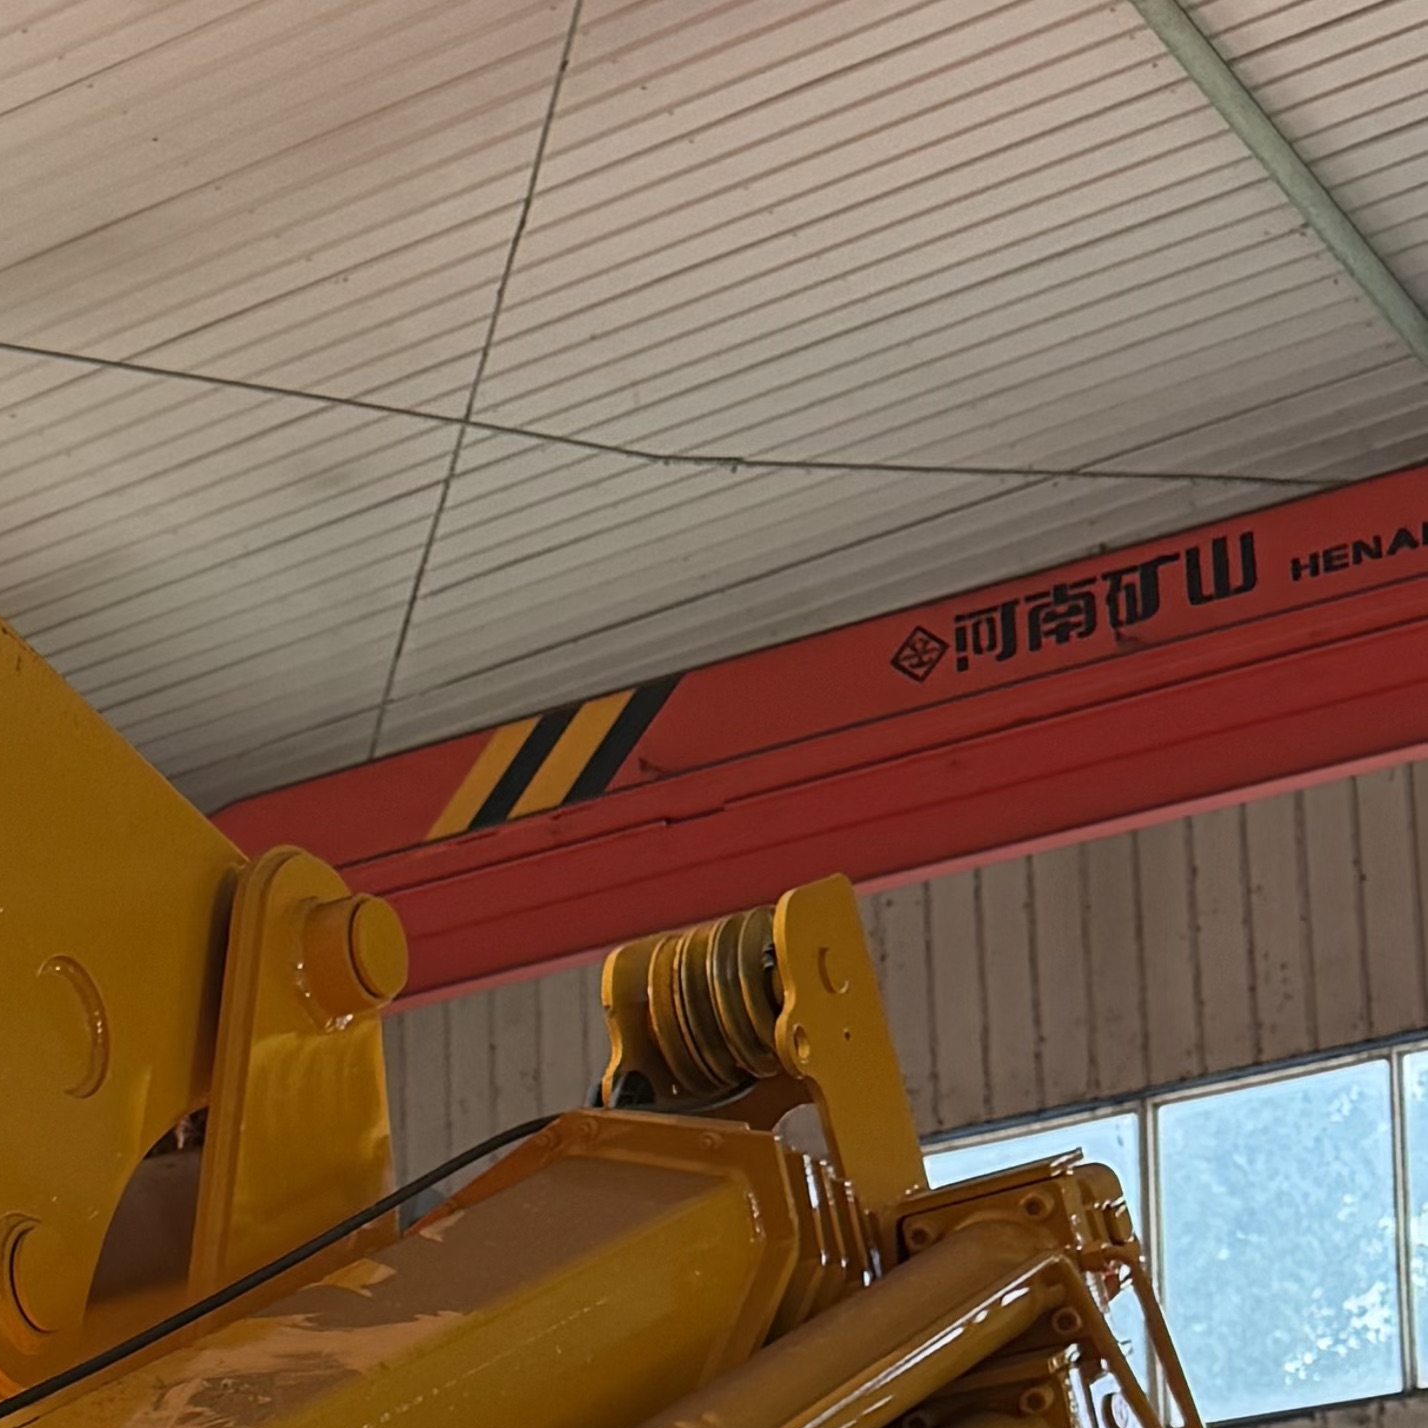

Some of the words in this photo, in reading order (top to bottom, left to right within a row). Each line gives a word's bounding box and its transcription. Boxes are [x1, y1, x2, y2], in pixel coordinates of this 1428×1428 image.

[954, 531, 1257, 672] 河南矿山
[1290, 521, 1428, 582] HENA
